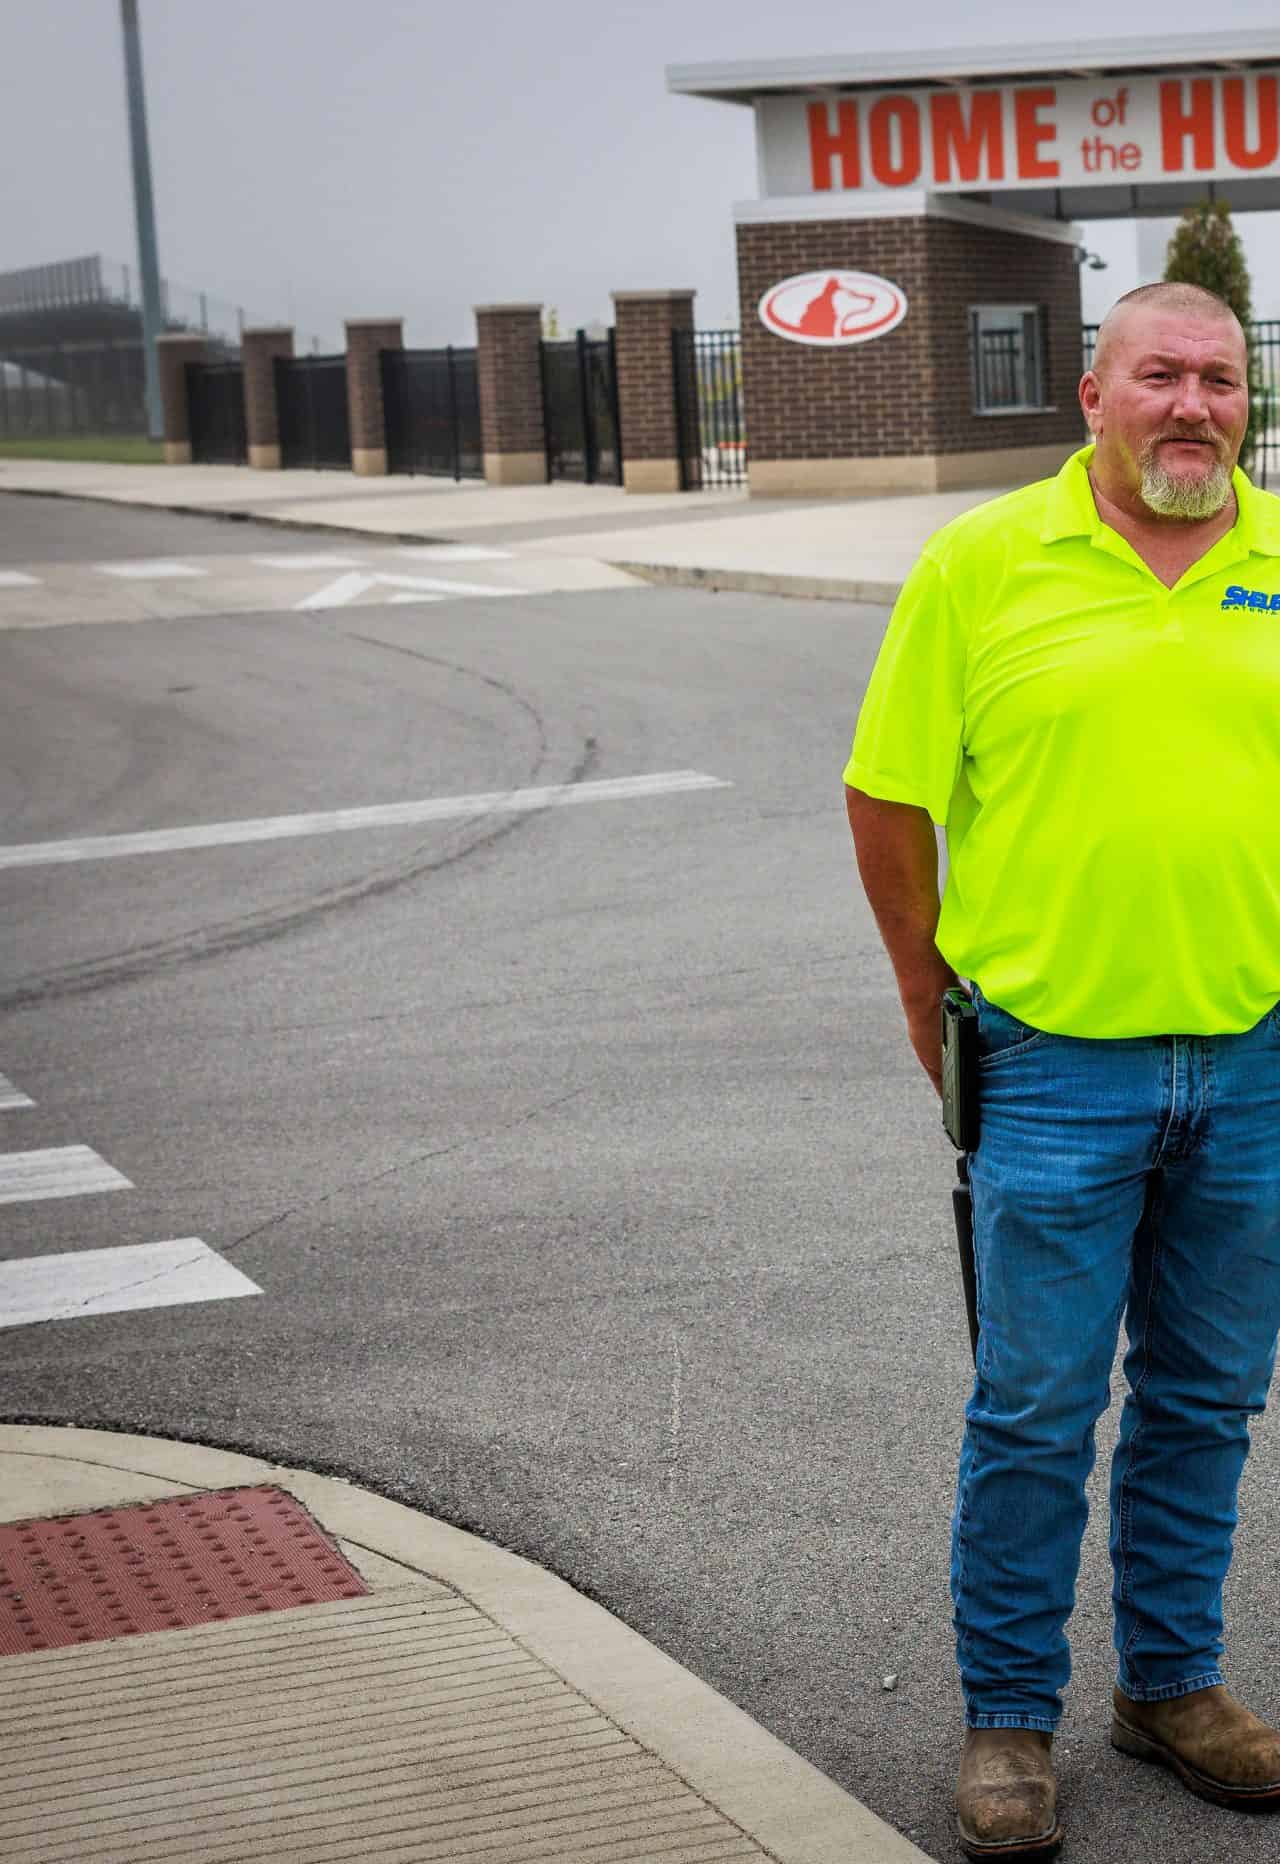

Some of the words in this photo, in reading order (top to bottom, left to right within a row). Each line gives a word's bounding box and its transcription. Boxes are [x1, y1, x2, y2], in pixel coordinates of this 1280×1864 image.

[1090, 88, 1129, 128] of
[808, 87, 1059, 192] HOME
[1081, 136, 1142, 172] the
